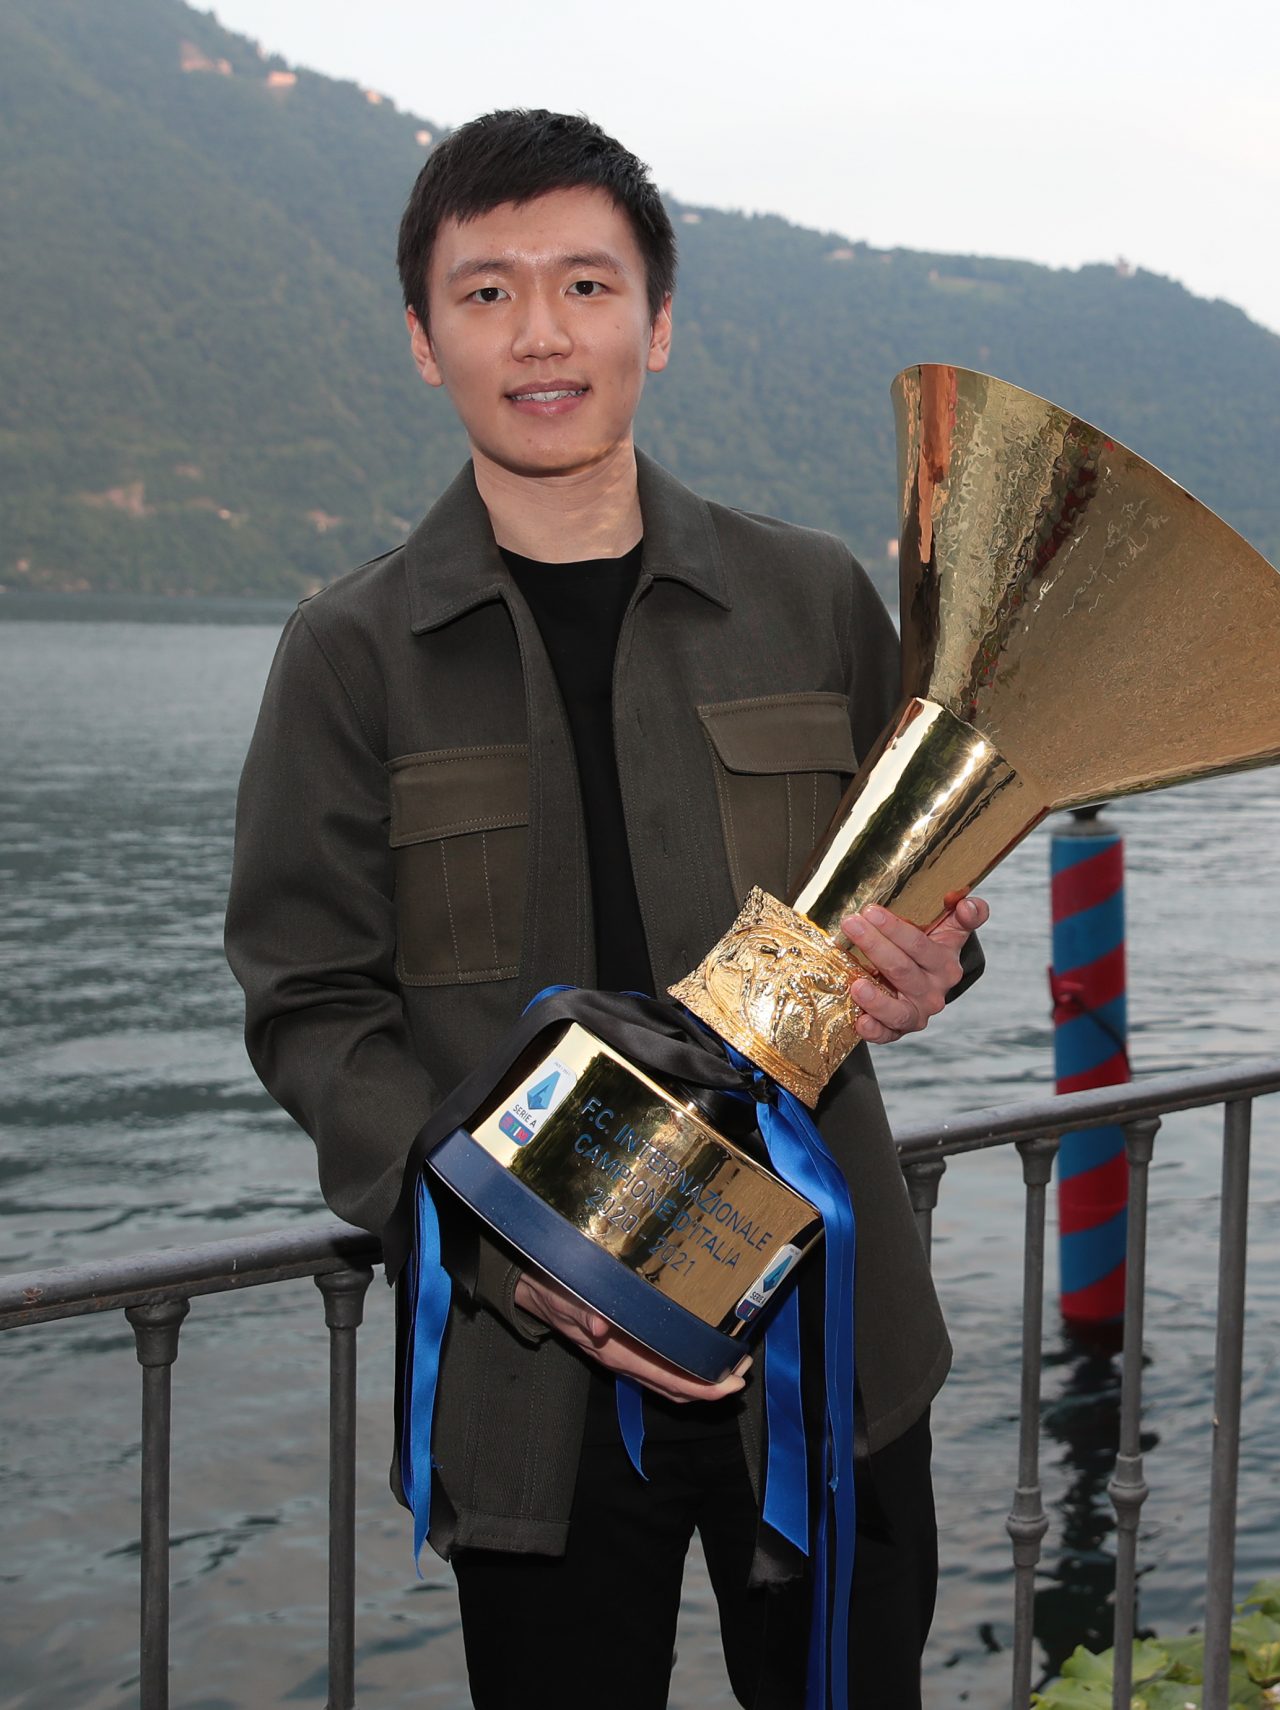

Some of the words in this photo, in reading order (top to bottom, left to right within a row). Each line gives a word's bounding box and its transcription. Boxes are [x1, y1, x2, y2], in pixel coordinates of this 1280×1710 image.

[508, 1122, 529, 1142] TIM
[512, 1103, 532, 1124] SERIE
[529, 1119, 538, 1129] A
[574, 1133, 678, 1222] CAMPIONE
[671, 1209, 742, 1271] D'ITALIA
[585, 1186, 639, 1234] 2020
[648, 1235, 696, 1277] 2021
[613, 1123, 773, 1252] INTERNAZIONALE
